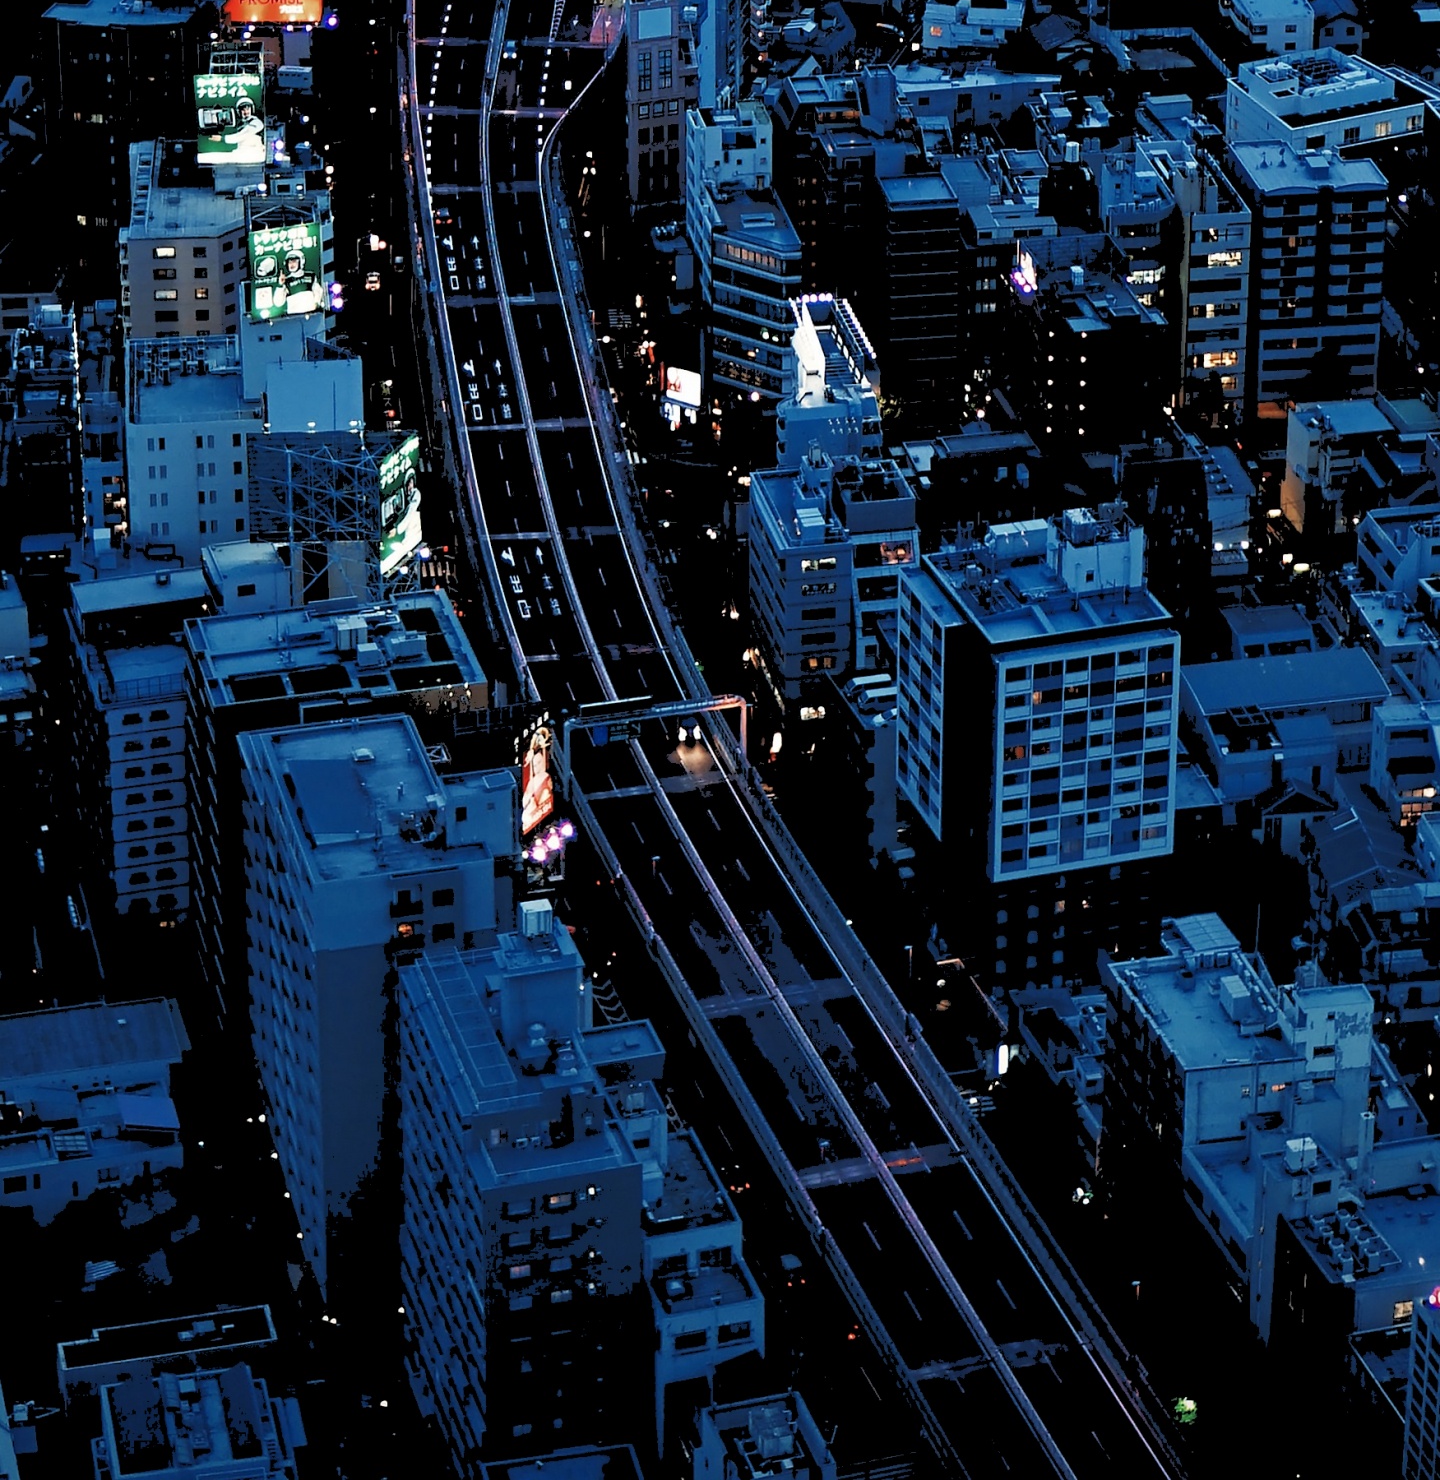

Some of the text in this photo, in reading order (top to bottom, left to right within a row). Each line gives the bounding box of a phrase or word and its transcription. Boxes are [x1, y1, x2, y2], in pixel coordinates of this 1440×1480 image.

[196, 86, 248, 98] ナビタイム
